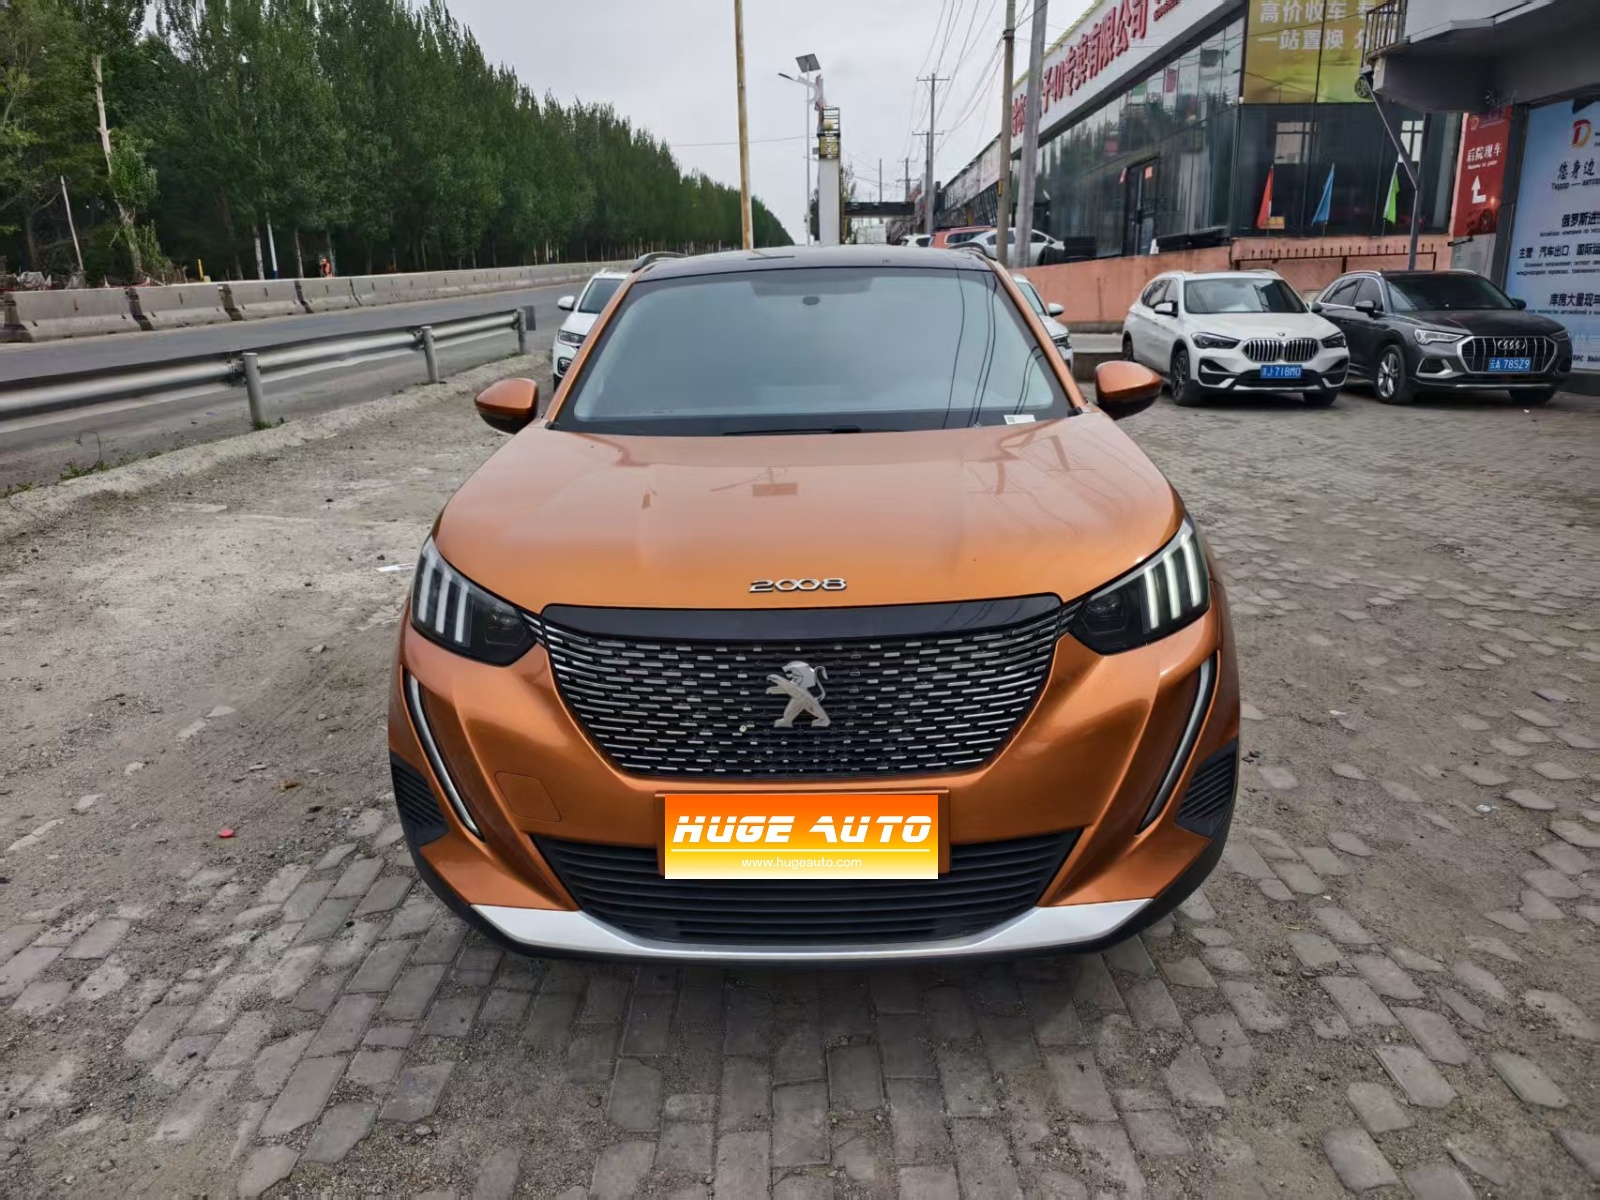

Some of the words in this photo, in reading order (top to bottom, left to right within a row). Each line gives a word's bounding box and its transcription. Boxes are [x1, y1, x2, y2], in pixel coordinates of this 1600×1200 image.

[1260, 0, 1346, 22] 高价收车
[1257, 29, 1344, 50] 一站置换
[749, 578, 848, 593] 2008
